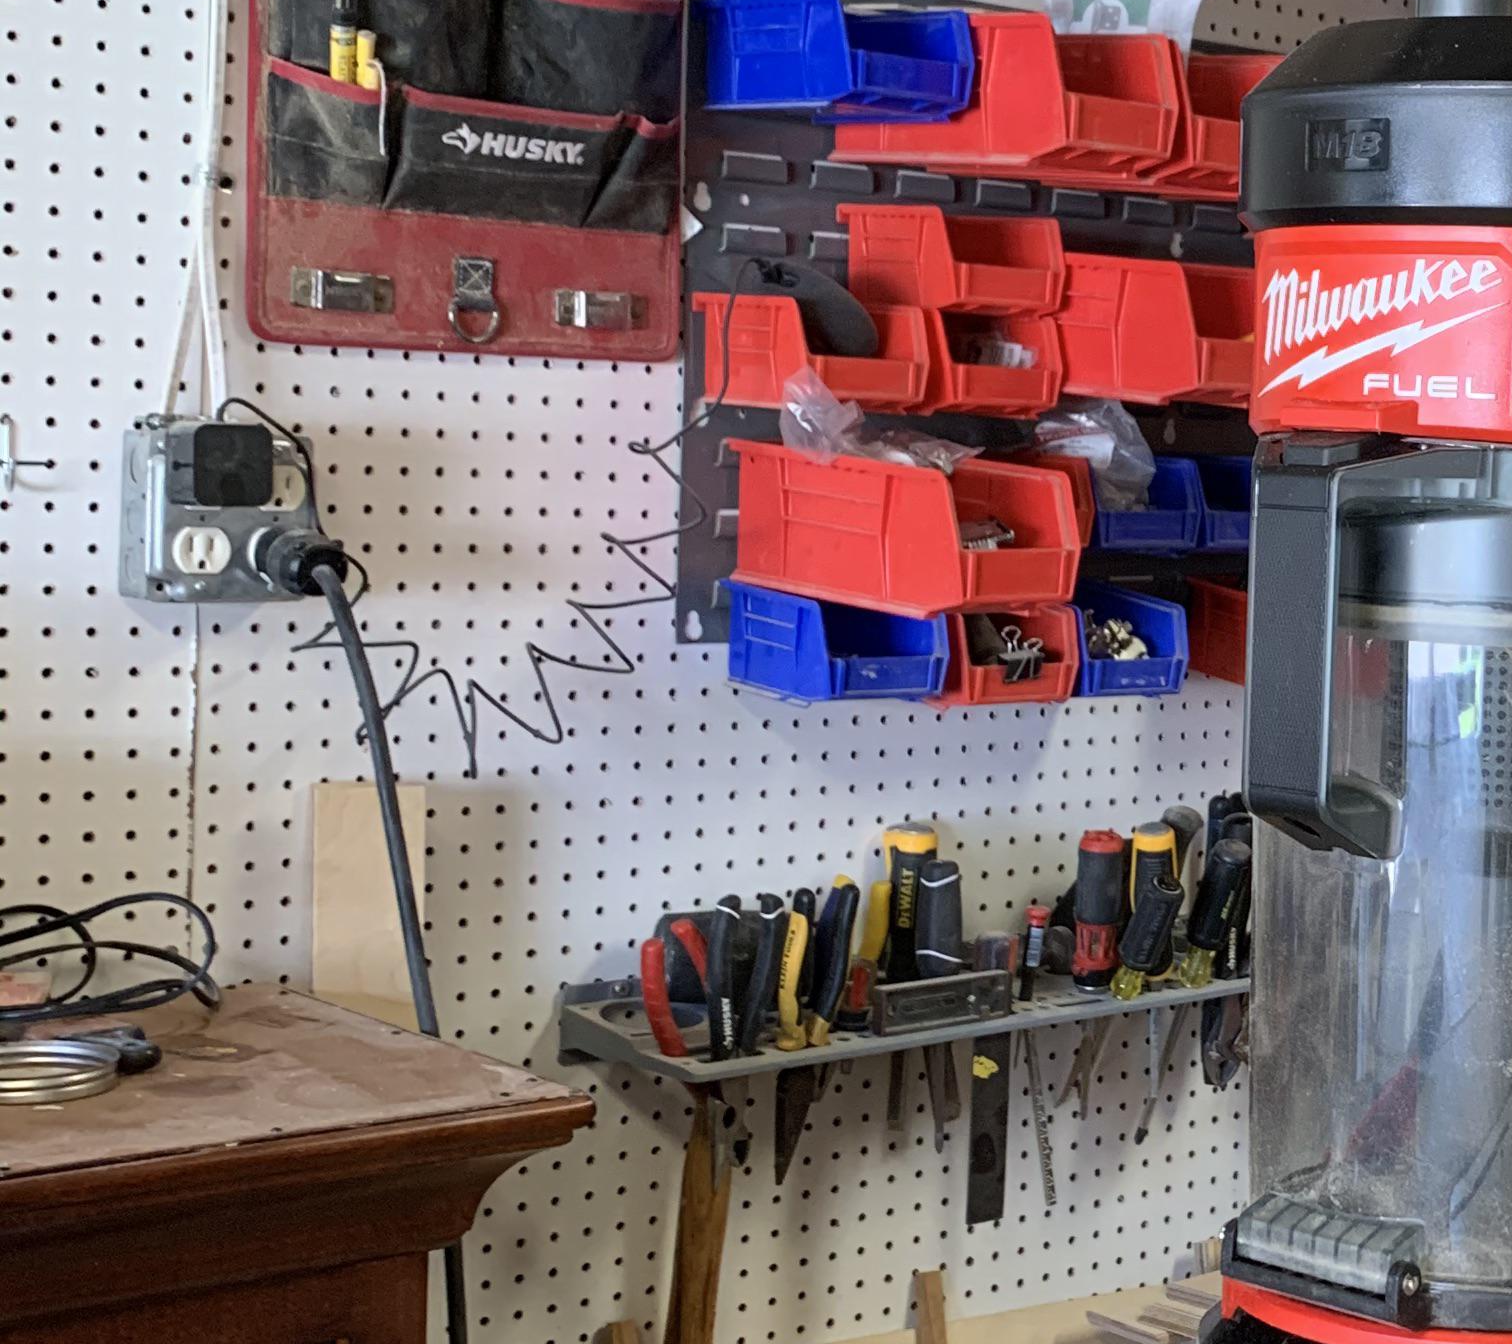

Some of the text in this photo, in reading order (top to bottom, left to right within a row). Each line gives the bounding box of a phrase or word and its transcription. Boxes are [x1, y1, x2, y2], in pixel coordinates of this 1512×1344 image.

[1312, 130, 1385, 160] M18
[1261, 258, 1504, 367] Milwaukee
[1362, 373, 1497, 400] FUEL
[720, 997, 734, 1037] HUSKY
